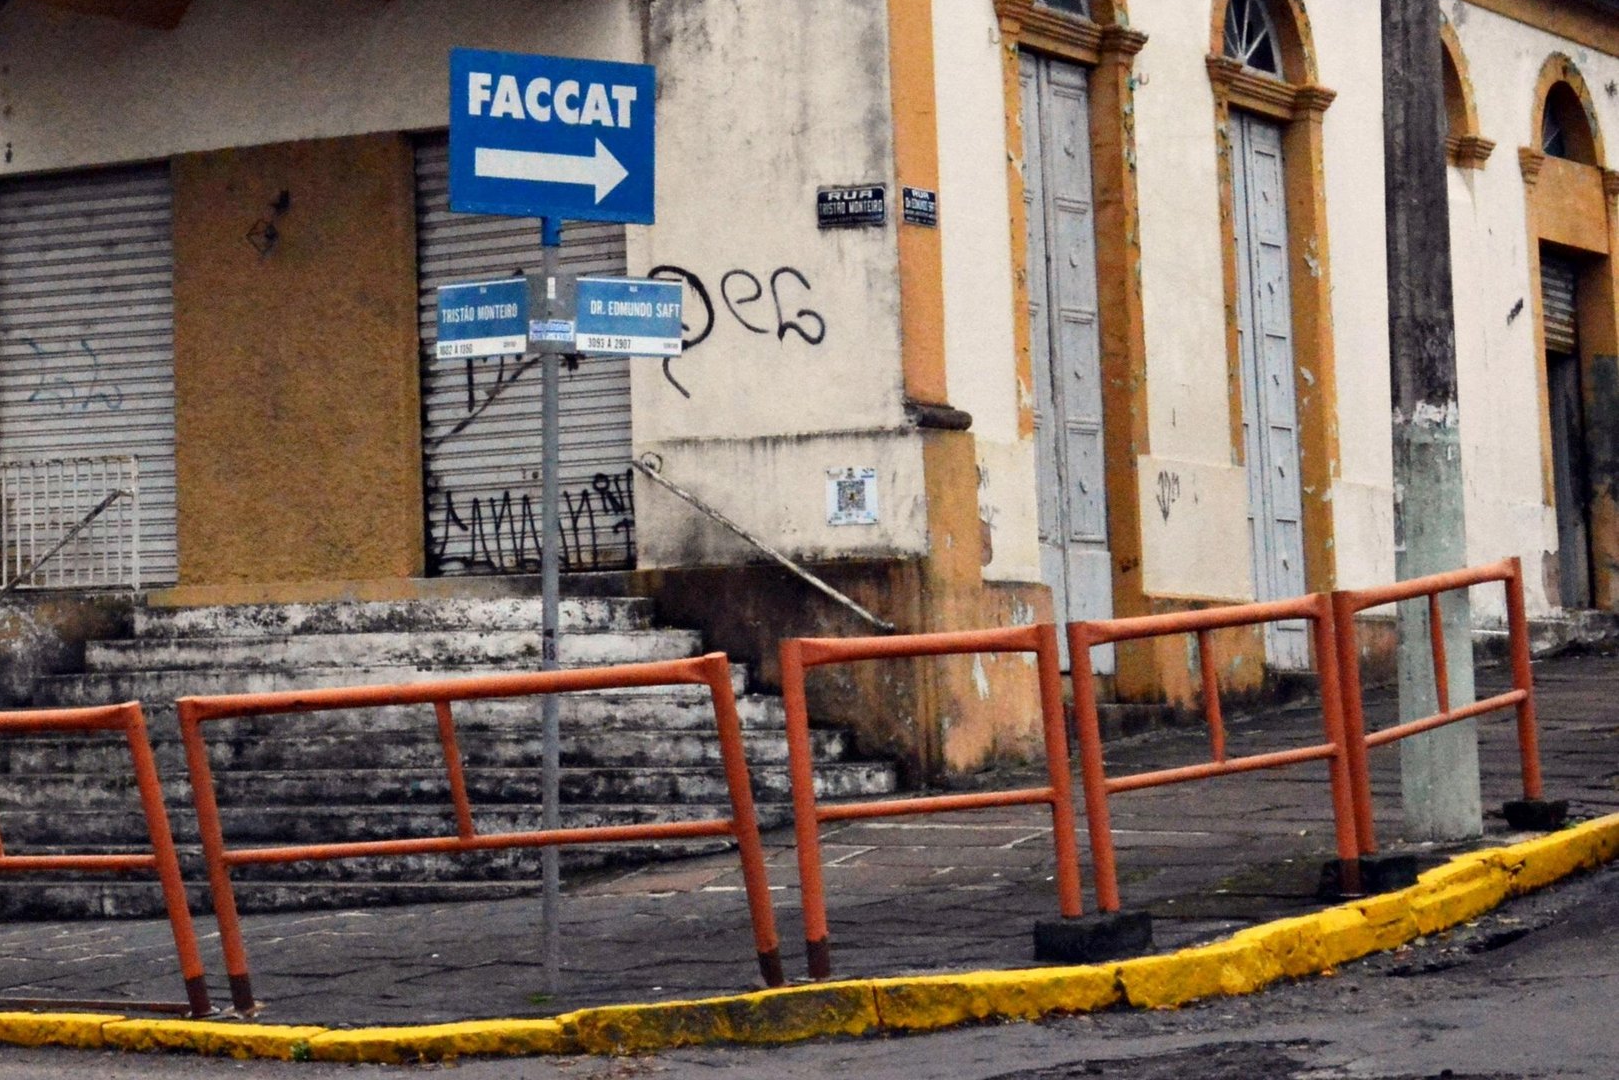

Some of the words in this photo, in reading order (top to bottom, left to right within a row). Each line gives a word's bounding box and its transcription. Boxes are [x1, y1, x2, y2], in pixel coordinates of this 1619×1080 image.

[468, 72, 637, 128] FACCAT
[828, 190, 872, 201] RUA
[442, 304, 475, 323] TRISTÃO
[477, 302, 518, 321] MONTEIRO
[590, 300, 606, 315] DR.
[608, 301, 653, 318] EDMUNDO
[655, 303, 681, 318] SAFT
[588, 337, 604, 348] 3093
[615, 338, 632, 350] 2907
